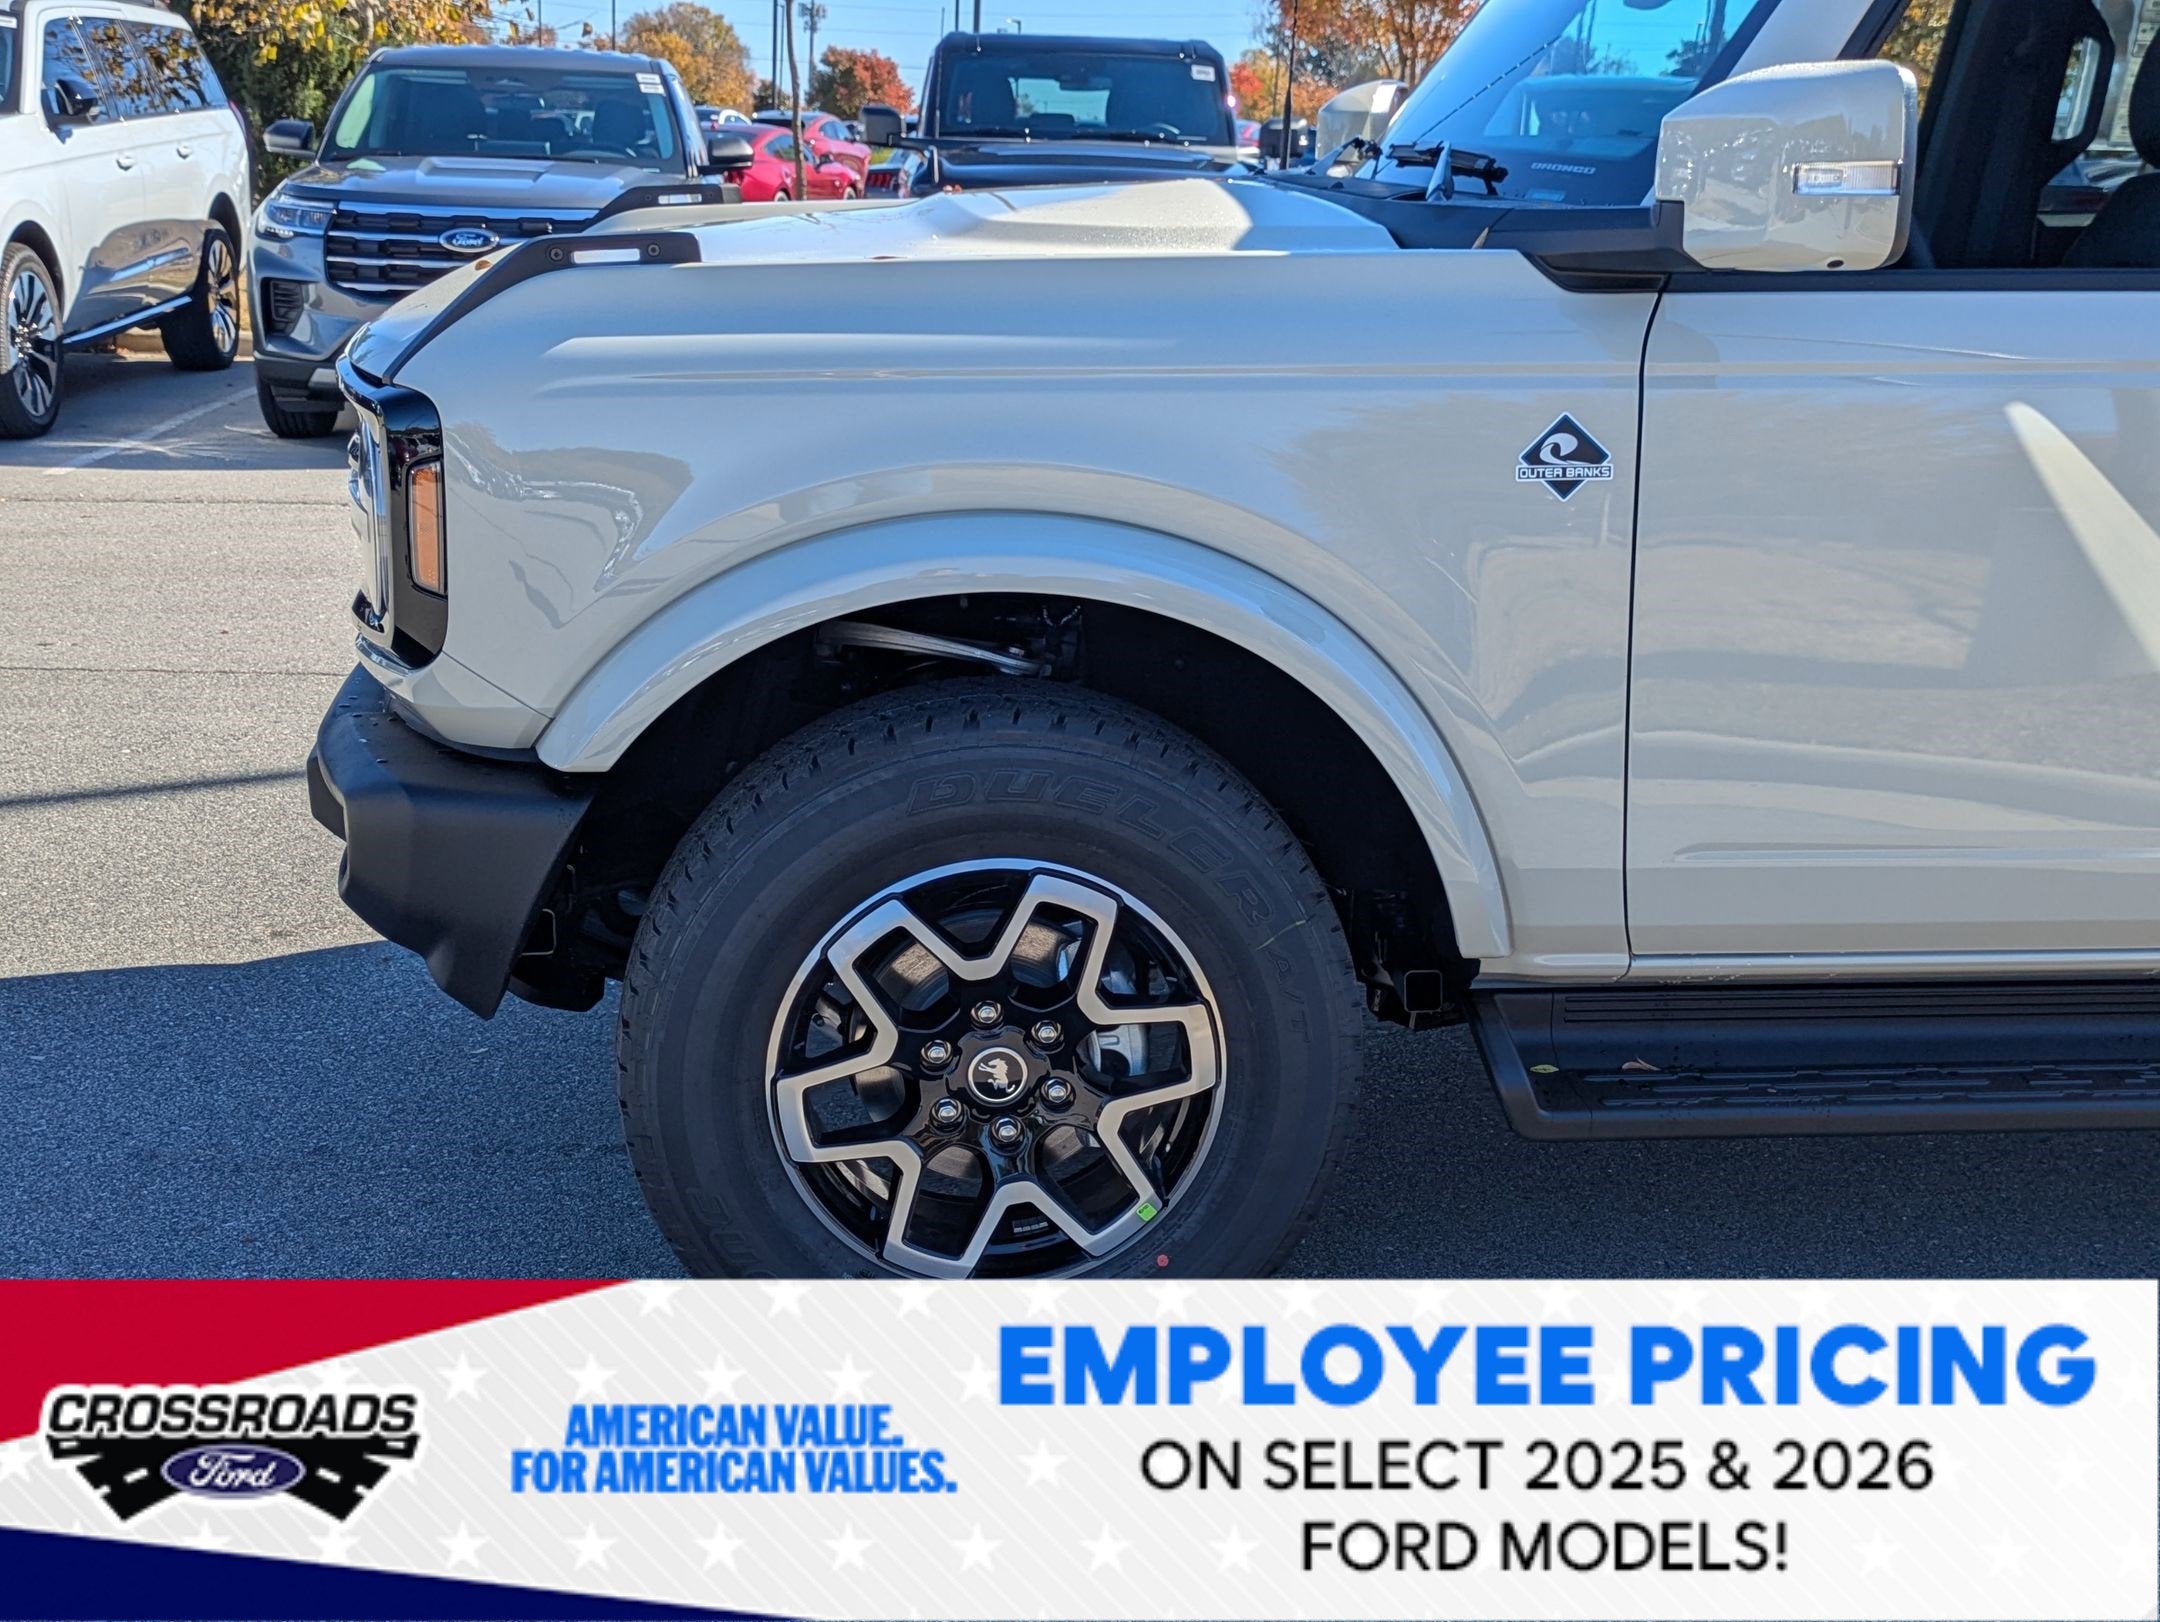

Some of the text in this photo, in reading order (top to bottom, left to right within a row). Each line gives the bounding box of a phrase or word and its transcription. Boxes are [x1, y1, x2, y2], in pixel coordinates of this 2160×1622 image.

[1530, 162, 1597, 175] BRONCO
[1519, 467, 1610, 478] OUTER BANKS
[903, 767, 1278, 930] DUELER
